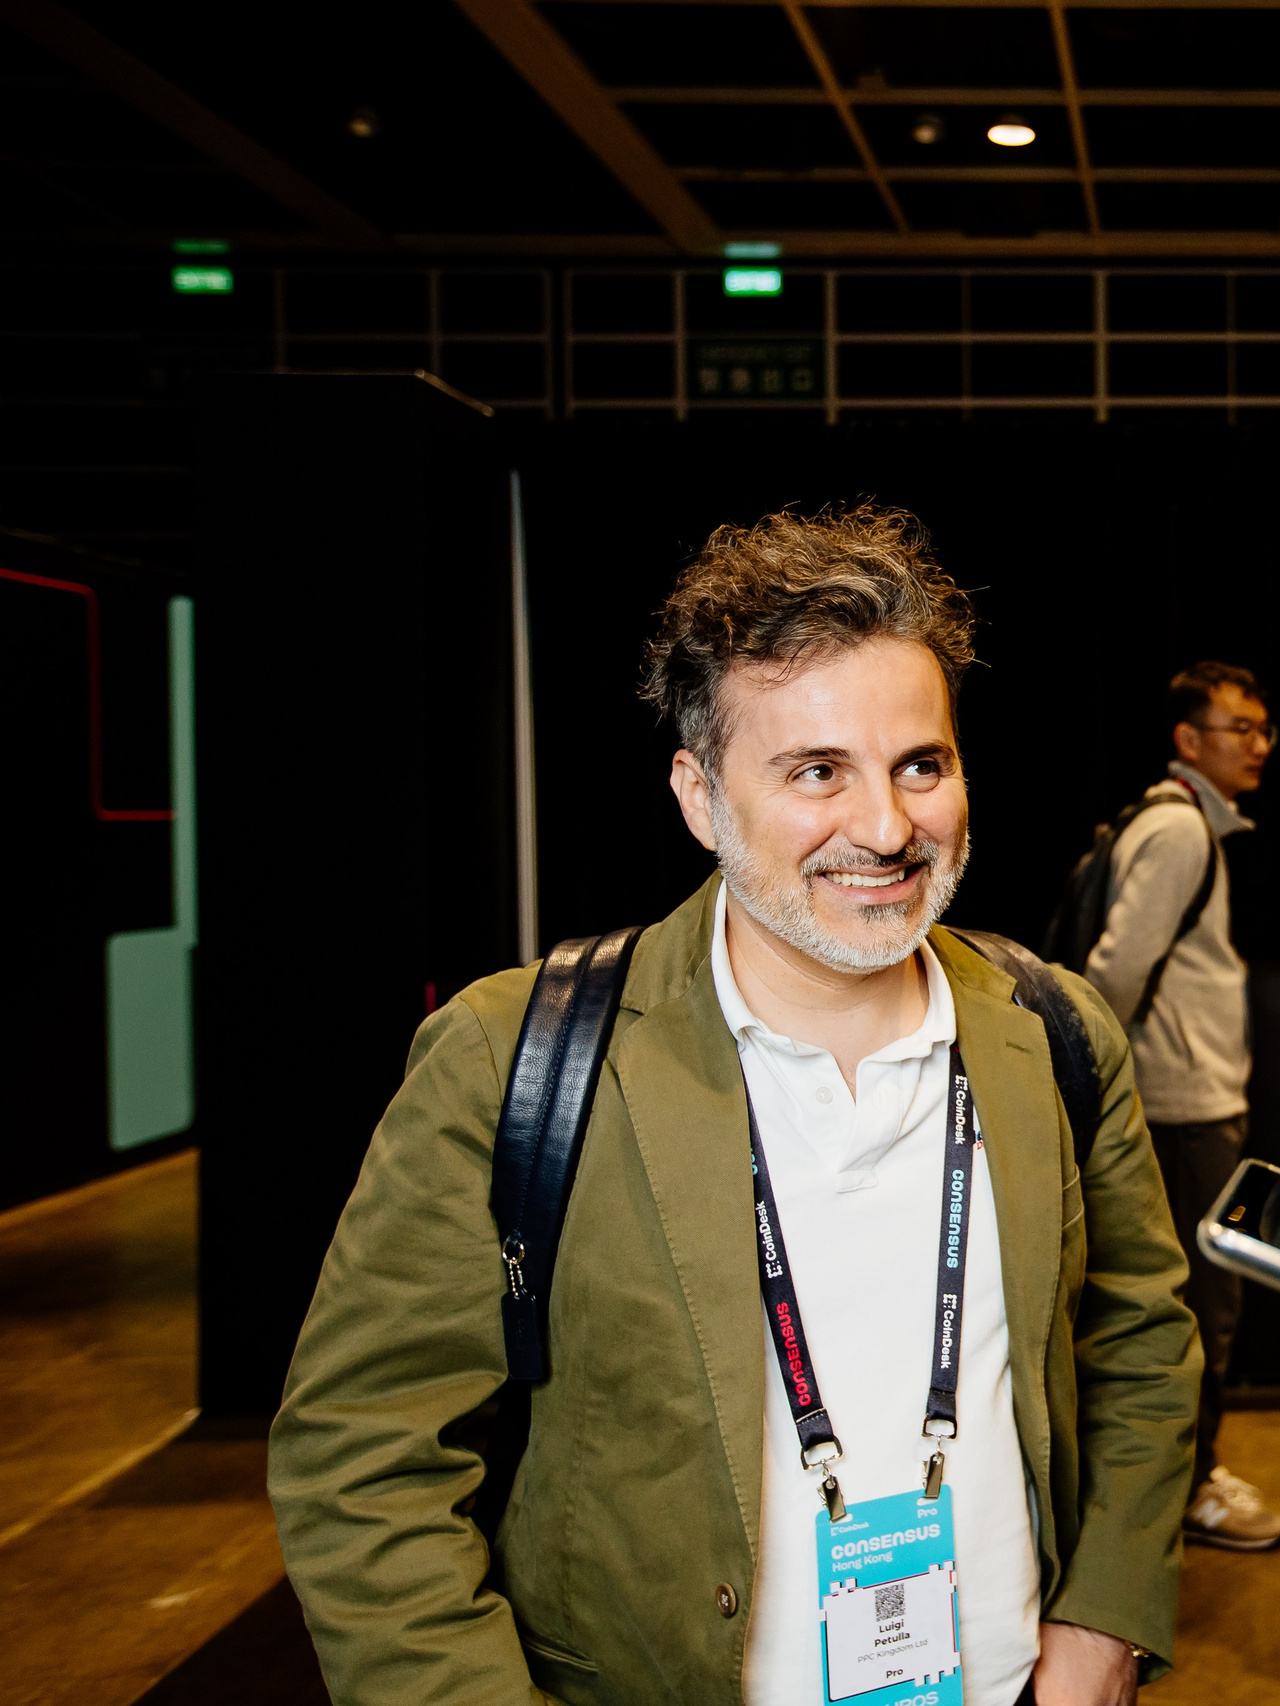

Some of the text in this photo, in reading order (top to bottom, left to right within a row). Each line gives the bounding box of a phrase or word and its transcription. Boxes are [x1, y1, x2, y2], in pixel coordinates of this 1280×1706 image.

[955, 1090, 967, 1145] CoinDesk
[755, 1200, 777, 1261] CoinDesk
[946, 1169, 965, 1269] CONSENSUS
[776, 1301, 812, 1407] CONSENSUS
[940, 1310, 955, 1369] CoinDesk
[917, 1508, 938, 1519] Pro
[831, 1523, 941, 1560] CONSENSUS
[832, 1551, 893, 1573] Hong Kong
[874, 1632, 911, 1648] Petulla
[879, 1619, 905, 1634] Luigi
[857, 1639, 929, 1664] PPC Kingdom Ltd
[886, 1668, 904, 1679] Pro
